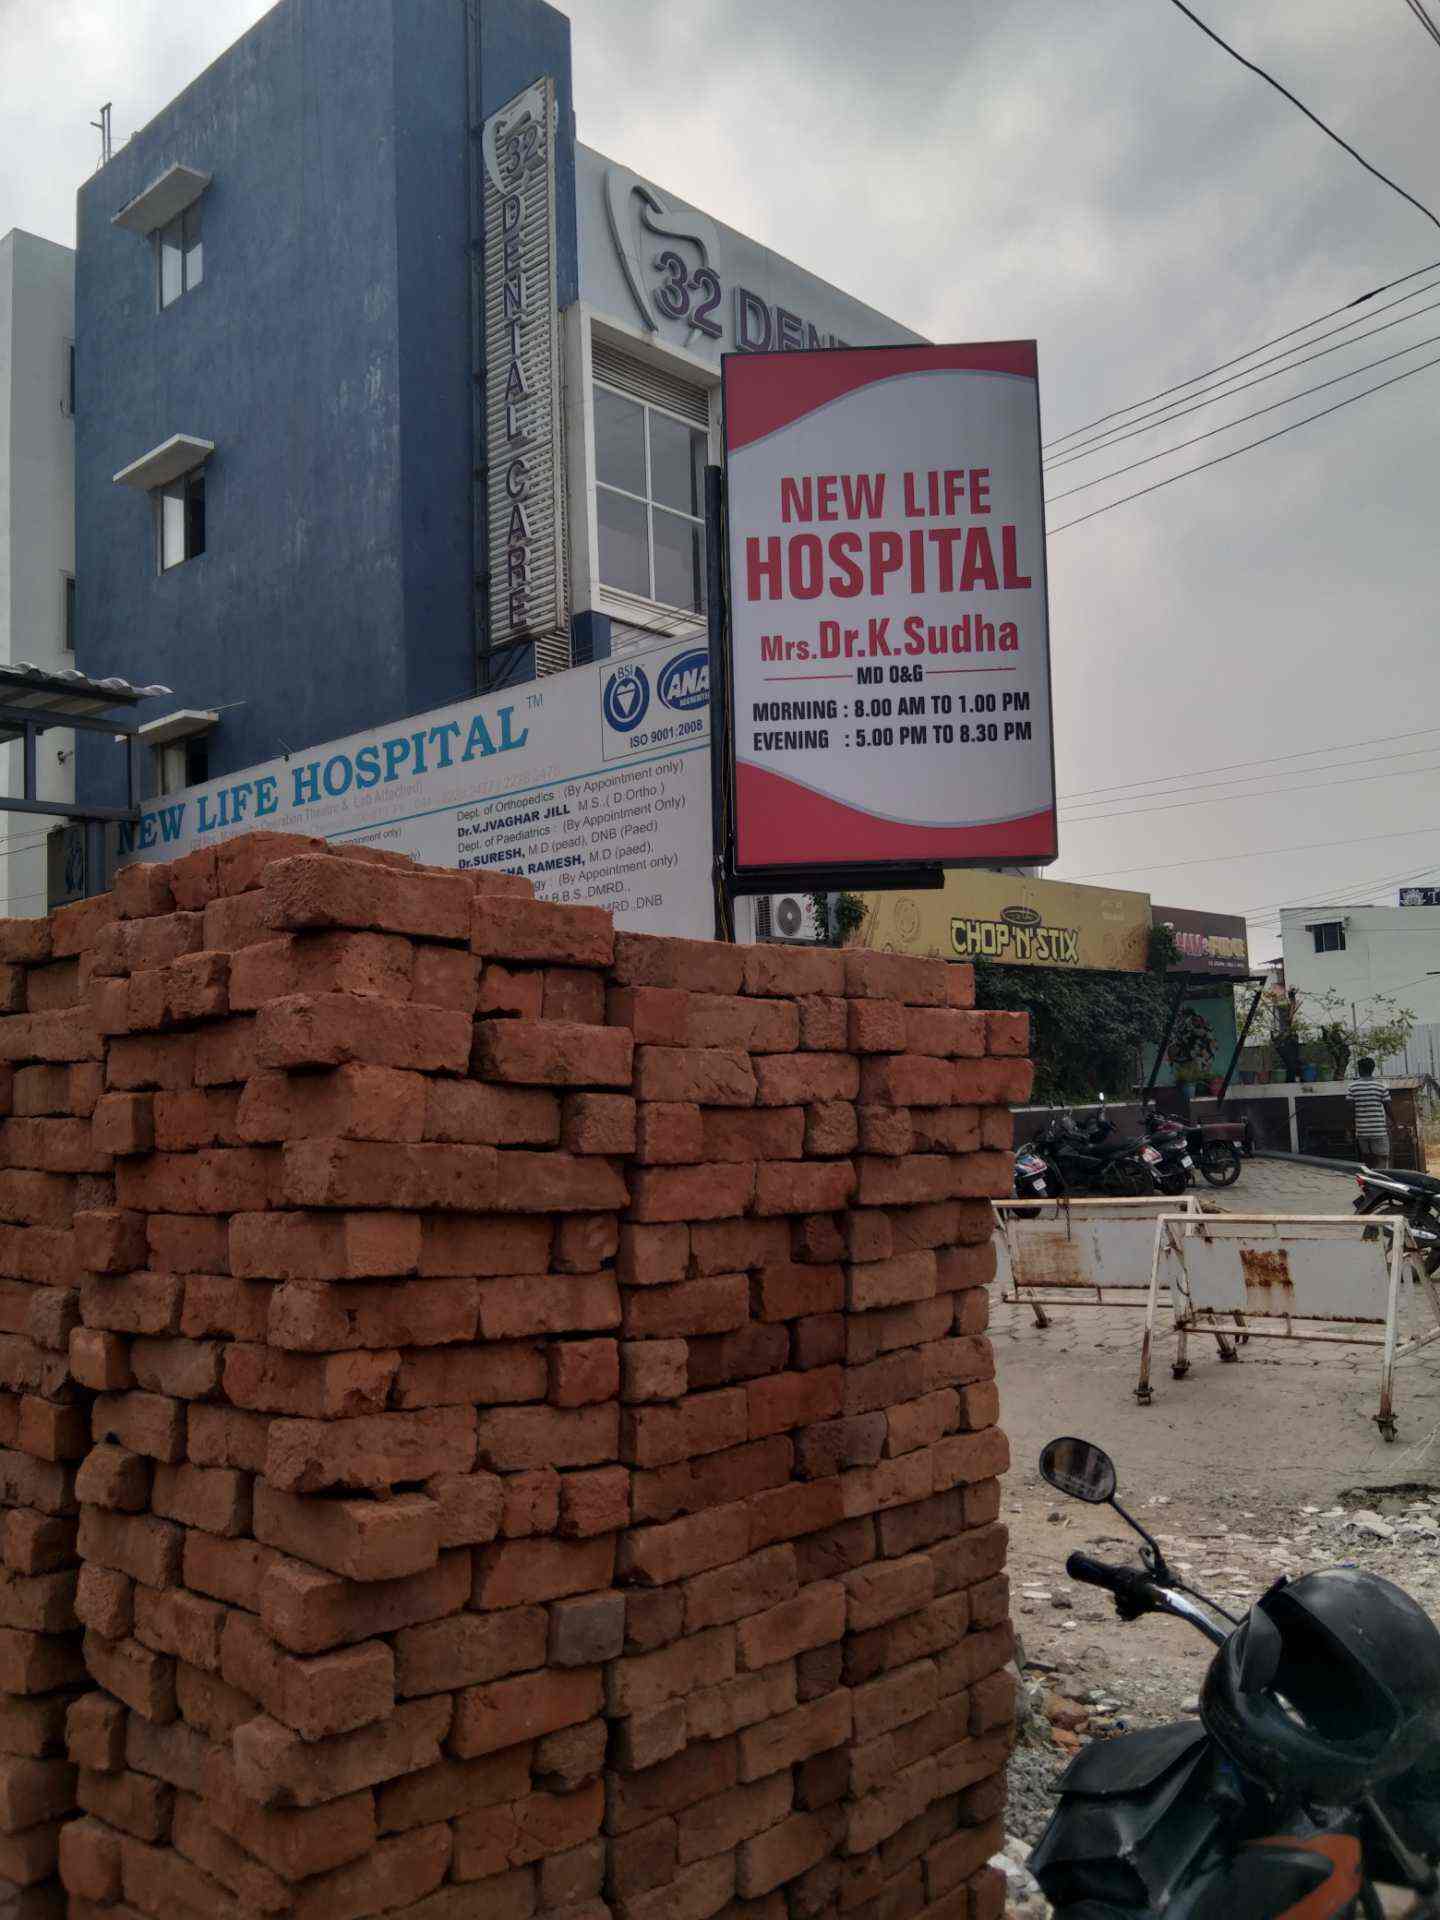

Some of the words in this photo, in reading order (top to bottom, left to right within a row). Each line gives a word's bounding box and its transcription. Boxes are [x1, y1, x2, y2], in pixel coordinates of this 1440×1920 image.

[505, 124, 538, 174] 32
[655, 251, 723, 340] 32
[781, 473, 886, 523] NEW
[903, 468, 992, 518] LIFE
[506, 459, 529, 630] CARE
[746, 525, 1032, 601] HOSPITAL
[857, 667, 884, 685] MD
[889, 664, 924, 683] O&G
[753, 701, 838, 722] MORNING
[854, 699, 892, 718] 8.00
[898, 697, 926, 716] AM
[931, 694, 952, 715] TO
[958, 694, 996, 713] 1.00
[1002, 692, 1031, 711] PM
[630, 734, 648, 749] ISO
[753, 730, 829, 751] EVENING
[856, 728, 893, 748] 5.00
[900, 726, 927, 745] PM
[934, 725, 954, 744] TO
[960, 723, 998, 743] 8.30
[1004, 722, 1033, 742] PM
[116, 803, 187, 856] NEW
[197, 776, 278, 833] LIFE
[291, 706, 530, 807] HOSPITAL
[483, 803, 493, 816] of
[494, 791, 555, 815] Orthopedics
[563, 784, 581, 799] (By
[583, 767, 652, 794] Appointment
[655, 758, 685, 777] only)
[484, 836, 495, 848] of
[496, 826, 551, 846] Paediatrics
[562, 818, 580, 834] (By
[583, 803, 652, 828] Appointment
[654, 794, 686, 812] Only)
[543, 803, 571, 819] JILL
[591, 828, 618, 846] DNB
[620, 820, 658, 839] (Paed)
[528, 854, 586, 875] RAMESH,
[558, 872, 576, 887] (By
[578, 858, 647, 883] Appointment
[650, 852, 680, 869] only)
